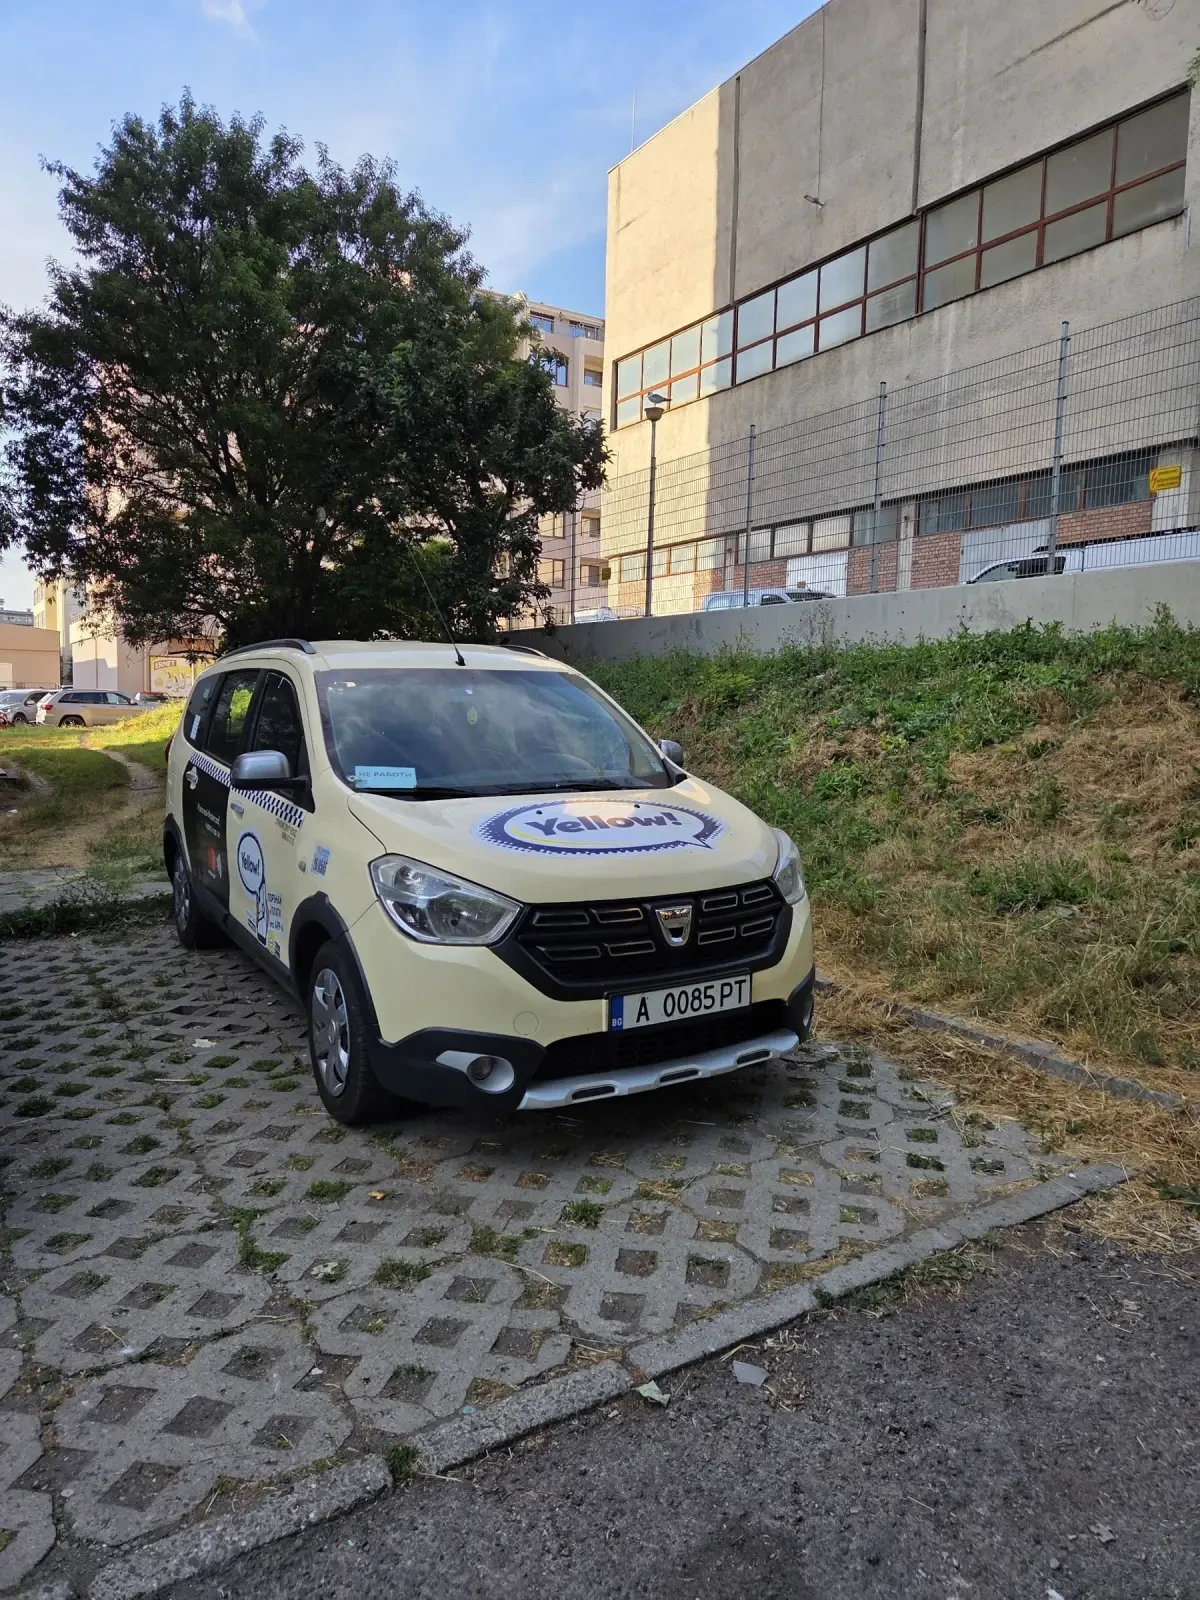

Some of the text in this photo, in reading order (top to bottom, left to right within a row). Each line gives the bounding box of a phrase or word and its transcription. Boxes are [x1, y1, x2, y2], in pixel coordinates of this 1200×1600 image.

[525, 811, 683, 836] Yellow!
[241, 851, 260, 876] Yellow!
[612, 1017, 623, 1027] BG
[636, 996, 650, 1023] A
